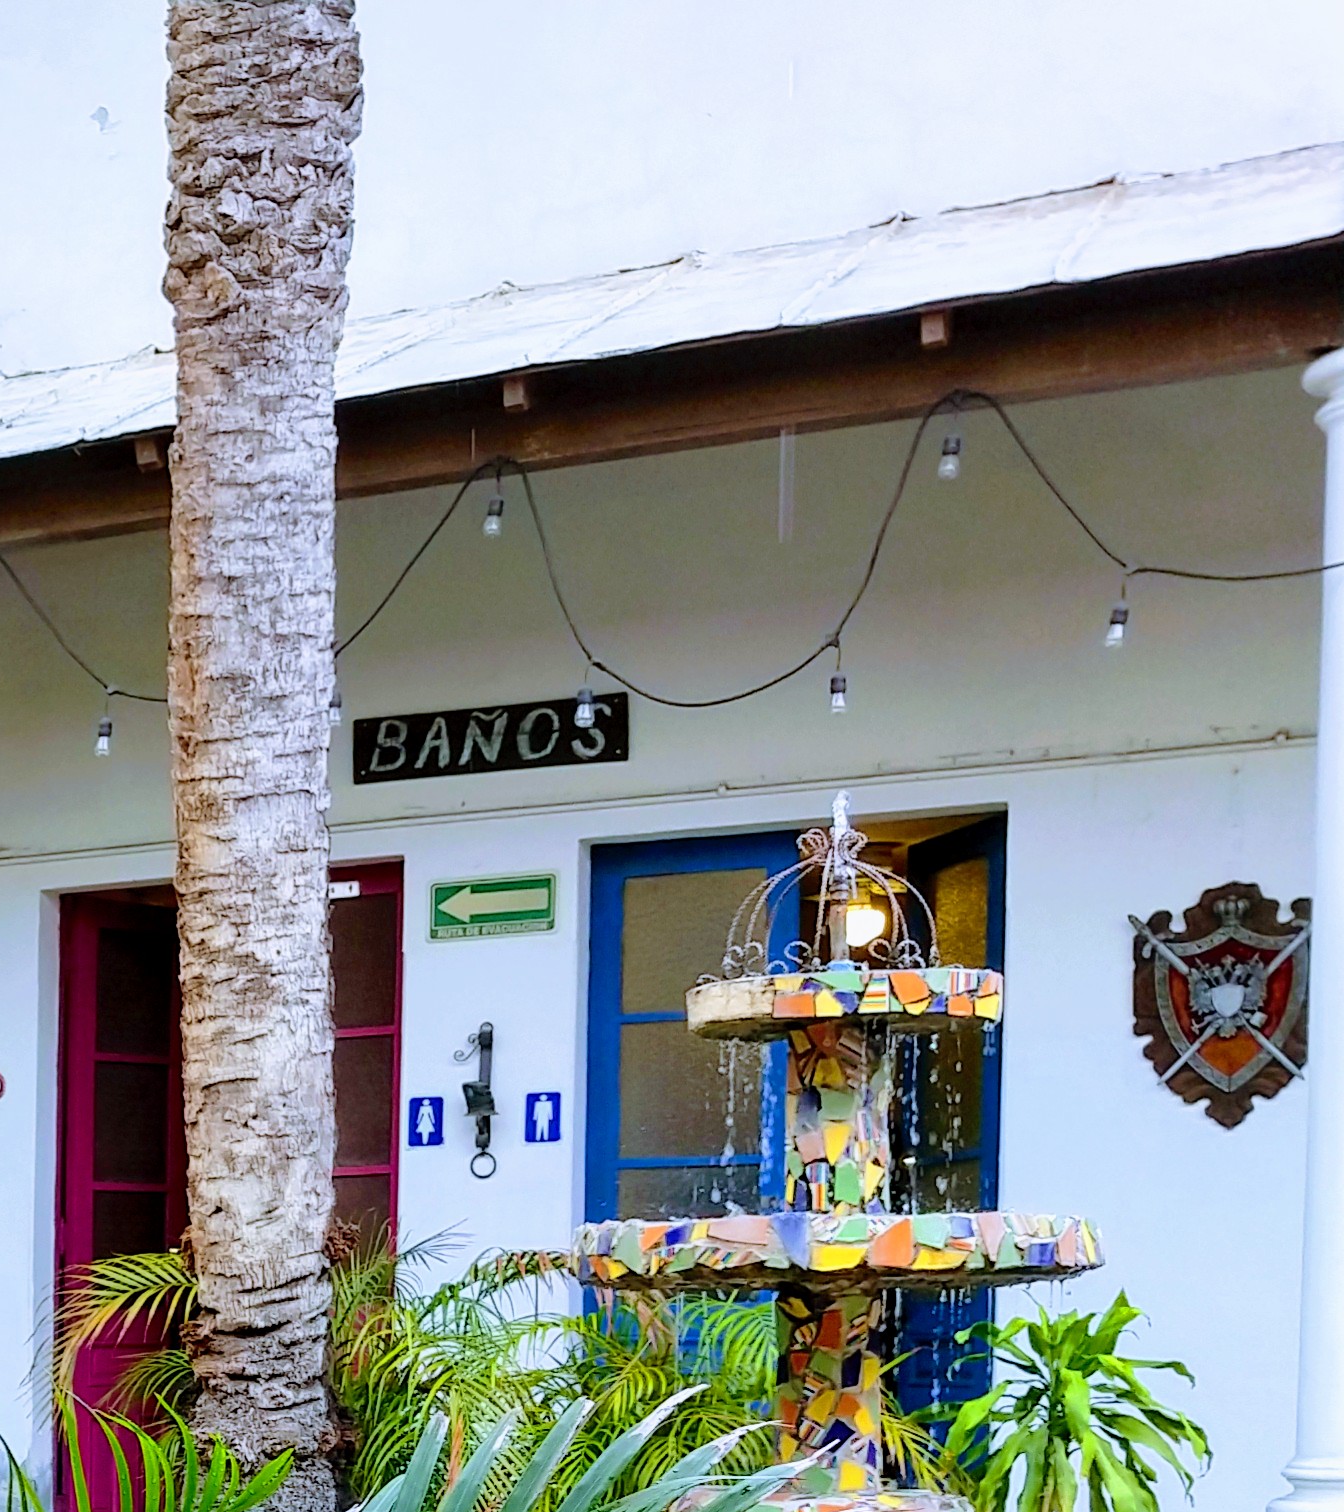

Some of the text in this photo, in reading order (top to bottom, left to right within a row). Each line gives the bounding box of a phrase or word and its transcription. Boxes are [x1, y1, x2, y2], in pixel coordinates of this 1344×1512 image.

[369, 701, 612, 773] BAÑOS
[437, 927, 464, 938] RUTA
[465, 926, 481, 936] DE
